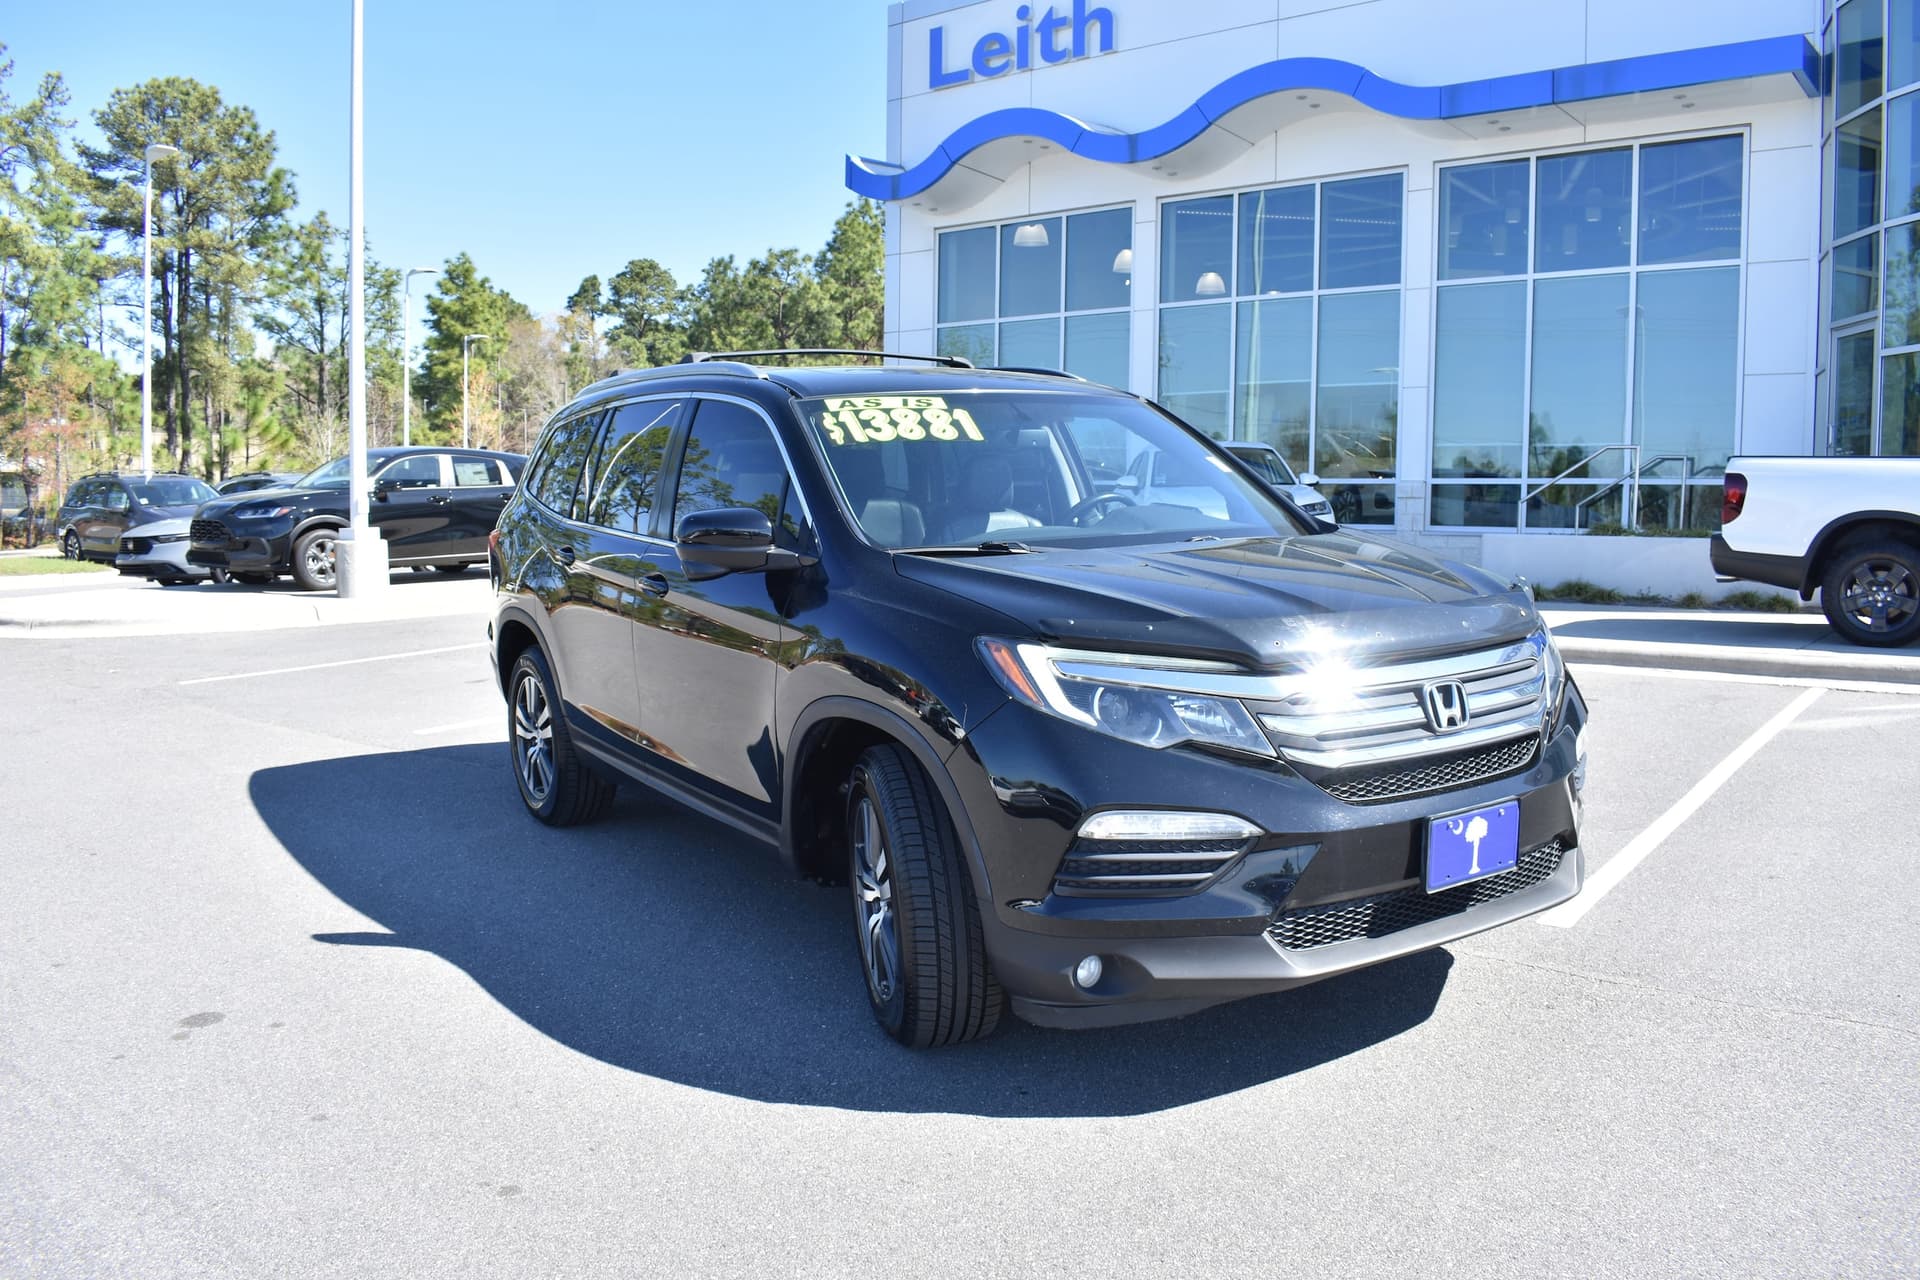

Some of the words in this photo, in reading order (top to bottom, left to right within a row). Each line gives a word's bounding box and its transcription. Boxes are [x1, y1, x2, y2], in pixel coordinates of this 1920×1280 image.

[929, 0, 1114, 89] Leith
[838, 398, 882, 409] AS
[901, 398, 933, 408] IS
[822, 408, 985, 445] $13881
